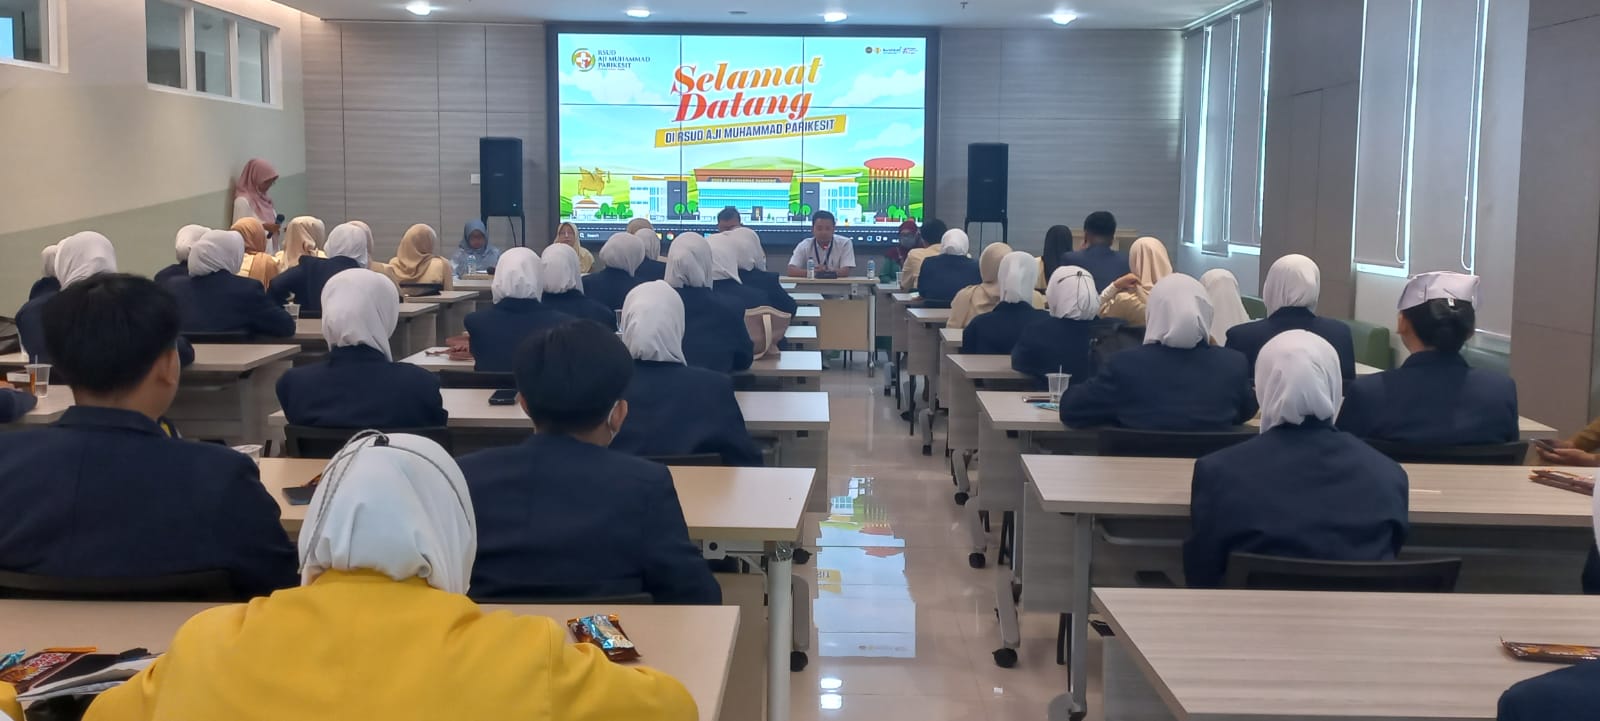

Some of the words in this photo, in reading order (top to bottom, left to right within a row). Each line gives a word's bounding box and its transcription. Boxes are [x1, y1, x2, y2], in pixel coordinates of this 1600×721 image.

[670, 57, 823, 95] Selamat
[671, 92, 813, 122] Datang
[665, 132, 675, 144] DI
[677, 130, 703, 142] RSUD
[705, 128, 723, 140] AJI
[724, 123, 783, 138] MUHAMMAD
[785, 119, 835, 134] PARIKESIT
